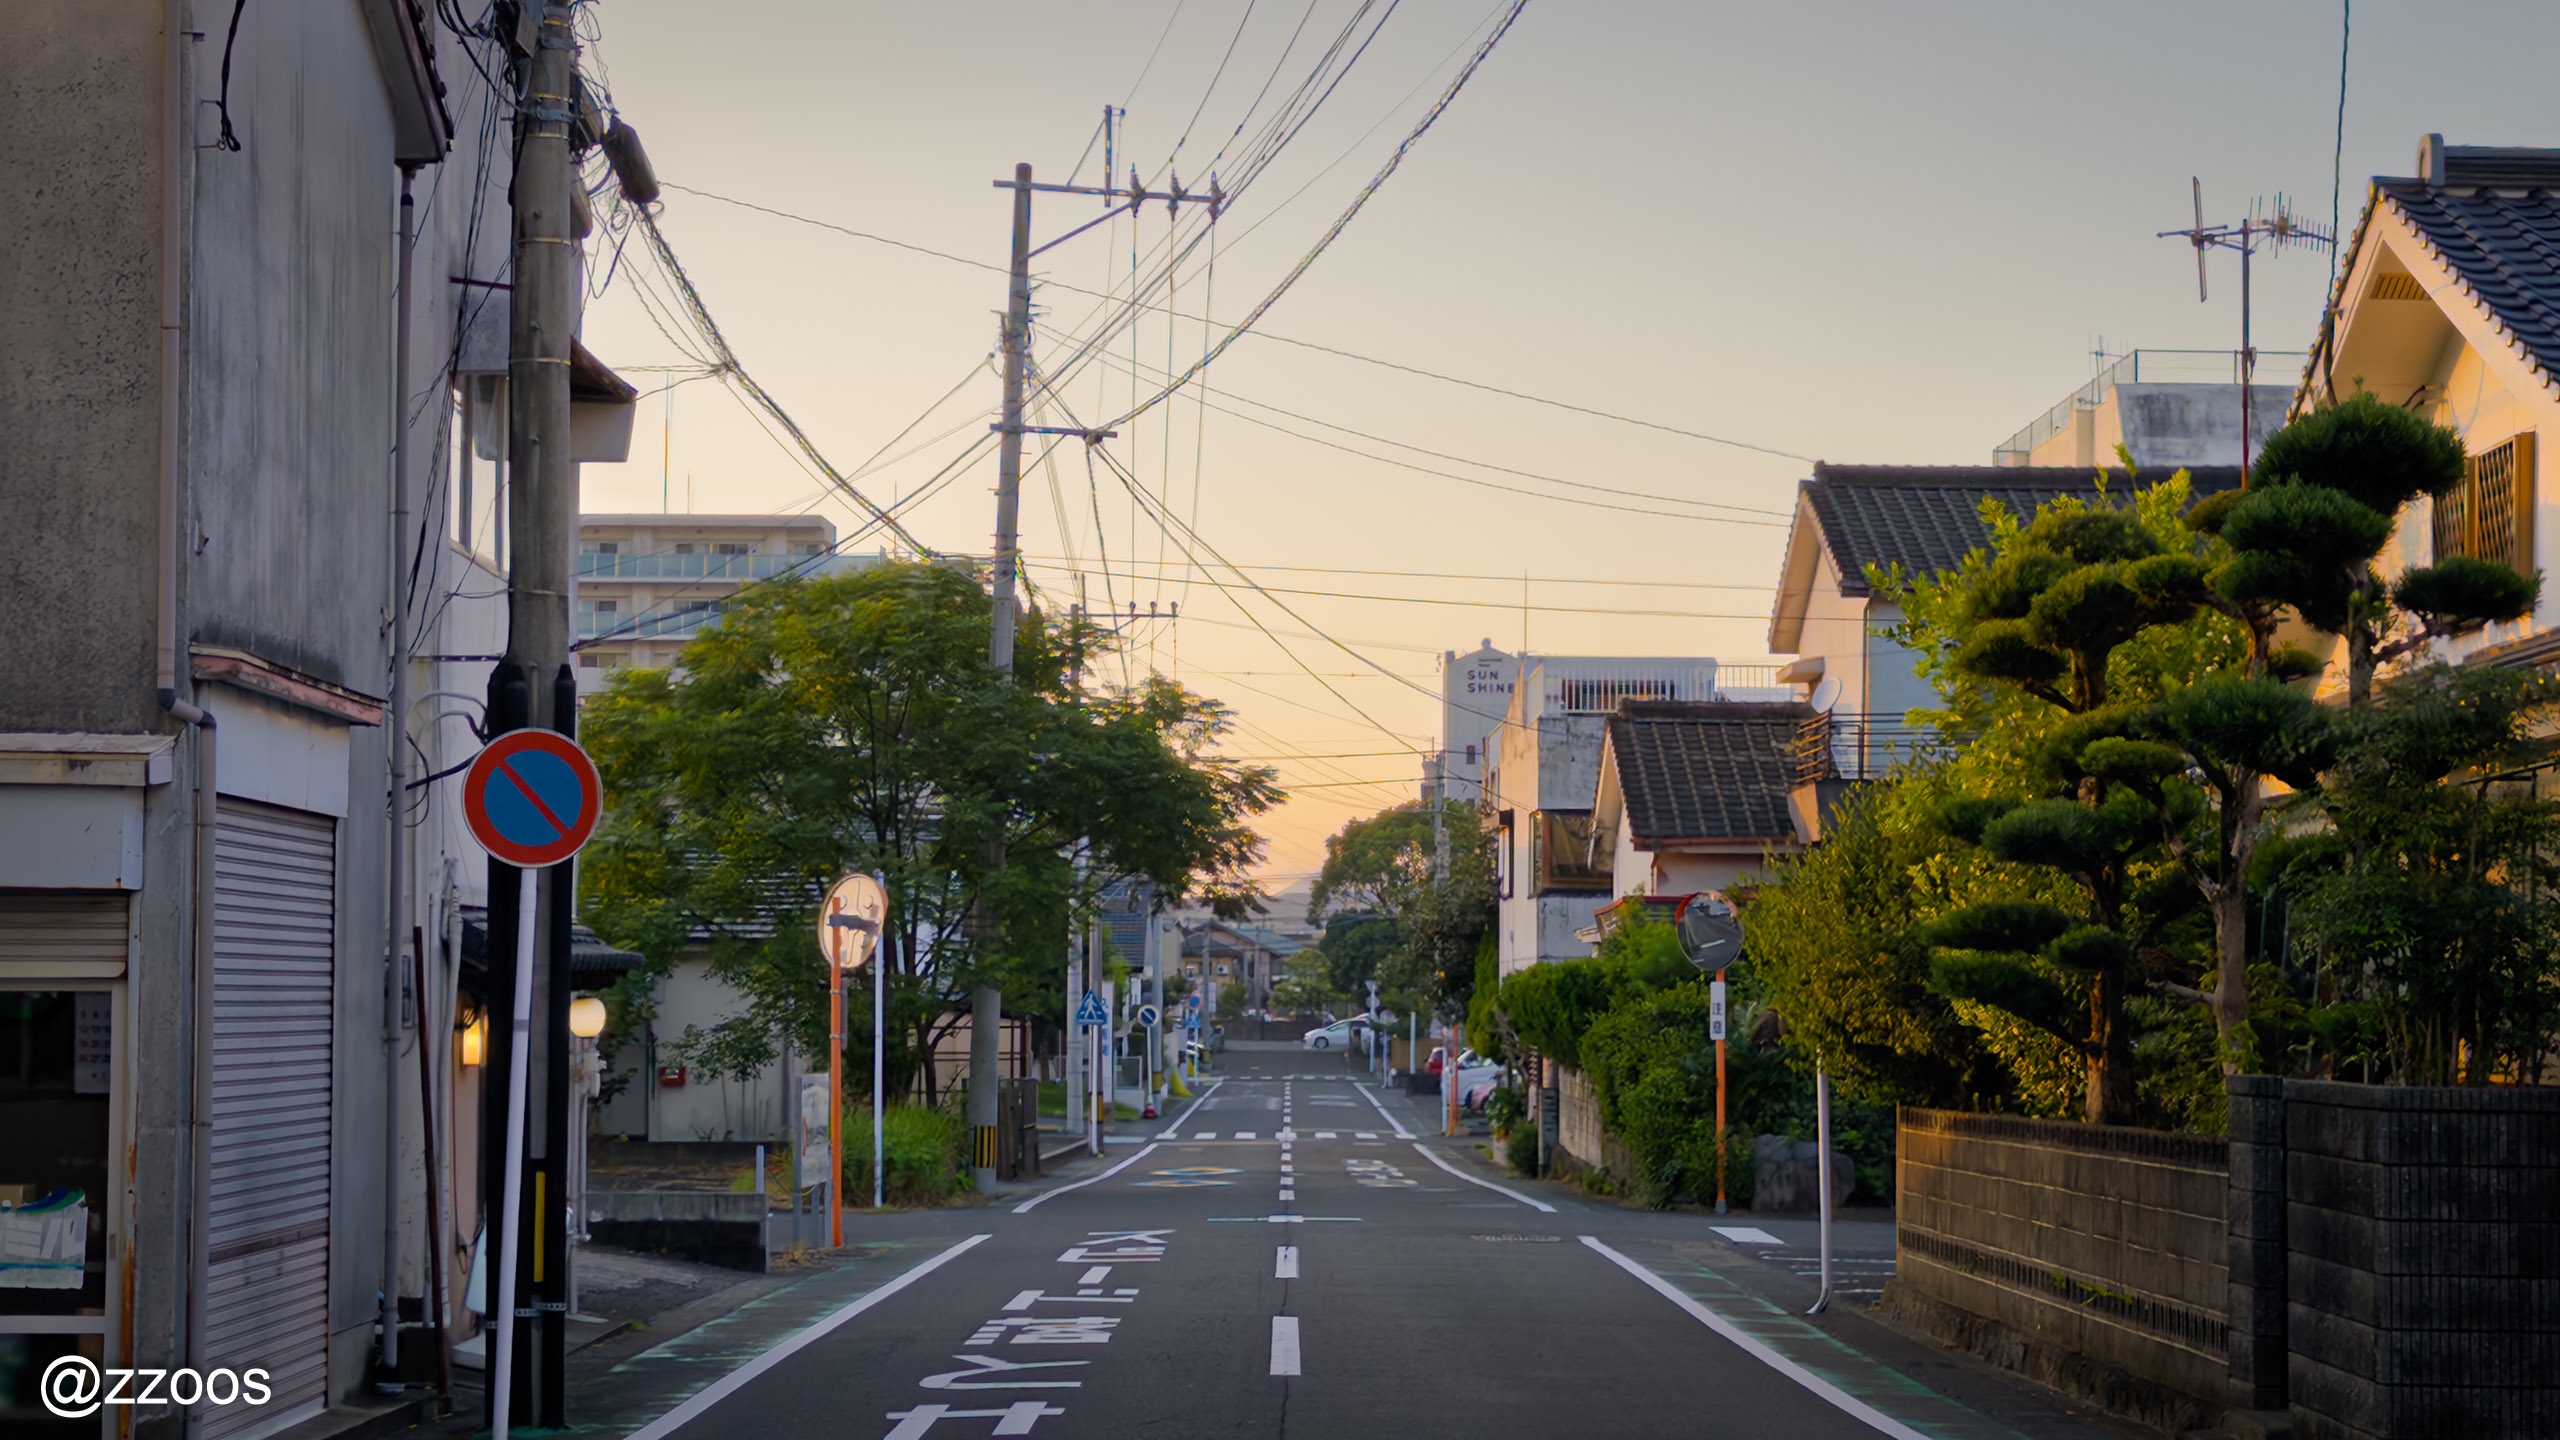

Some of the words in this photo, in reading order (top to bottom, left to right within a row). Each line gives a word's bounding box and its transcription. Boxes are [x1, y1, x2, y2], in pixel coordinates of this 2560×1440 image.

[1467, 670, 1499, 680] SUN
[1467, 683, 1514, 693] SHINE
[882, 1229, 1176, 1440] スピード落とせ
